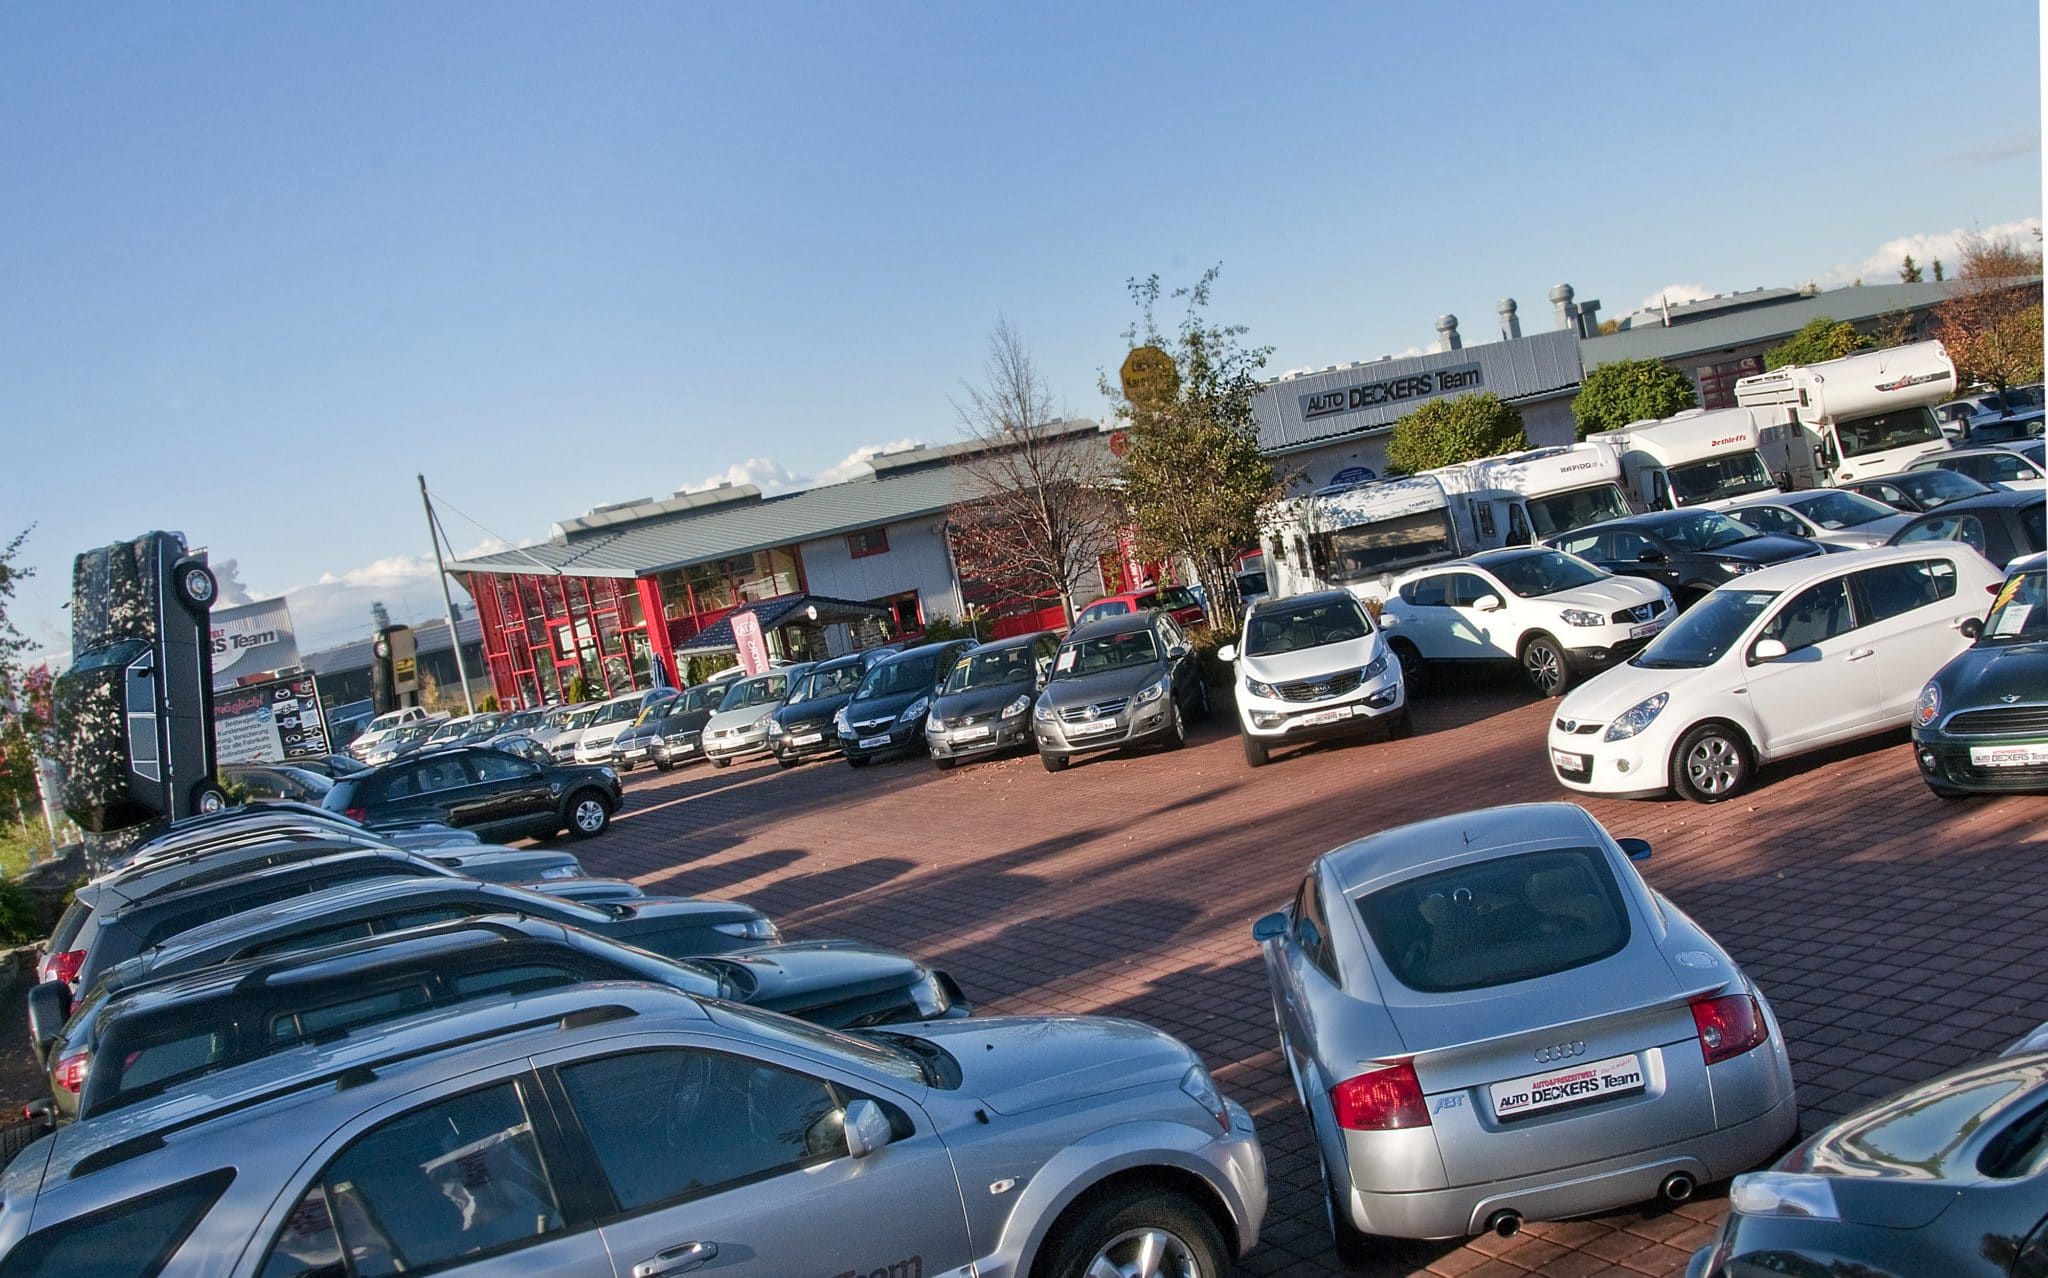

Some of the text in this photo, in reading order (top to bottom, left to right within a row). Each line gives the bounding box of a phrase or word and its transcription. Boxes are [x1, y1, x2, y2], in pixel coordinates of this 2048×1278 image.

[1307, 369, 1479, 412] AUTO DECKERS Team
[230, 630, 275, 649] Team
[1501, 1072, 1640, 1108] AUTO DECKERS Team
[1433, 1094, 1465, 1115] ABT
